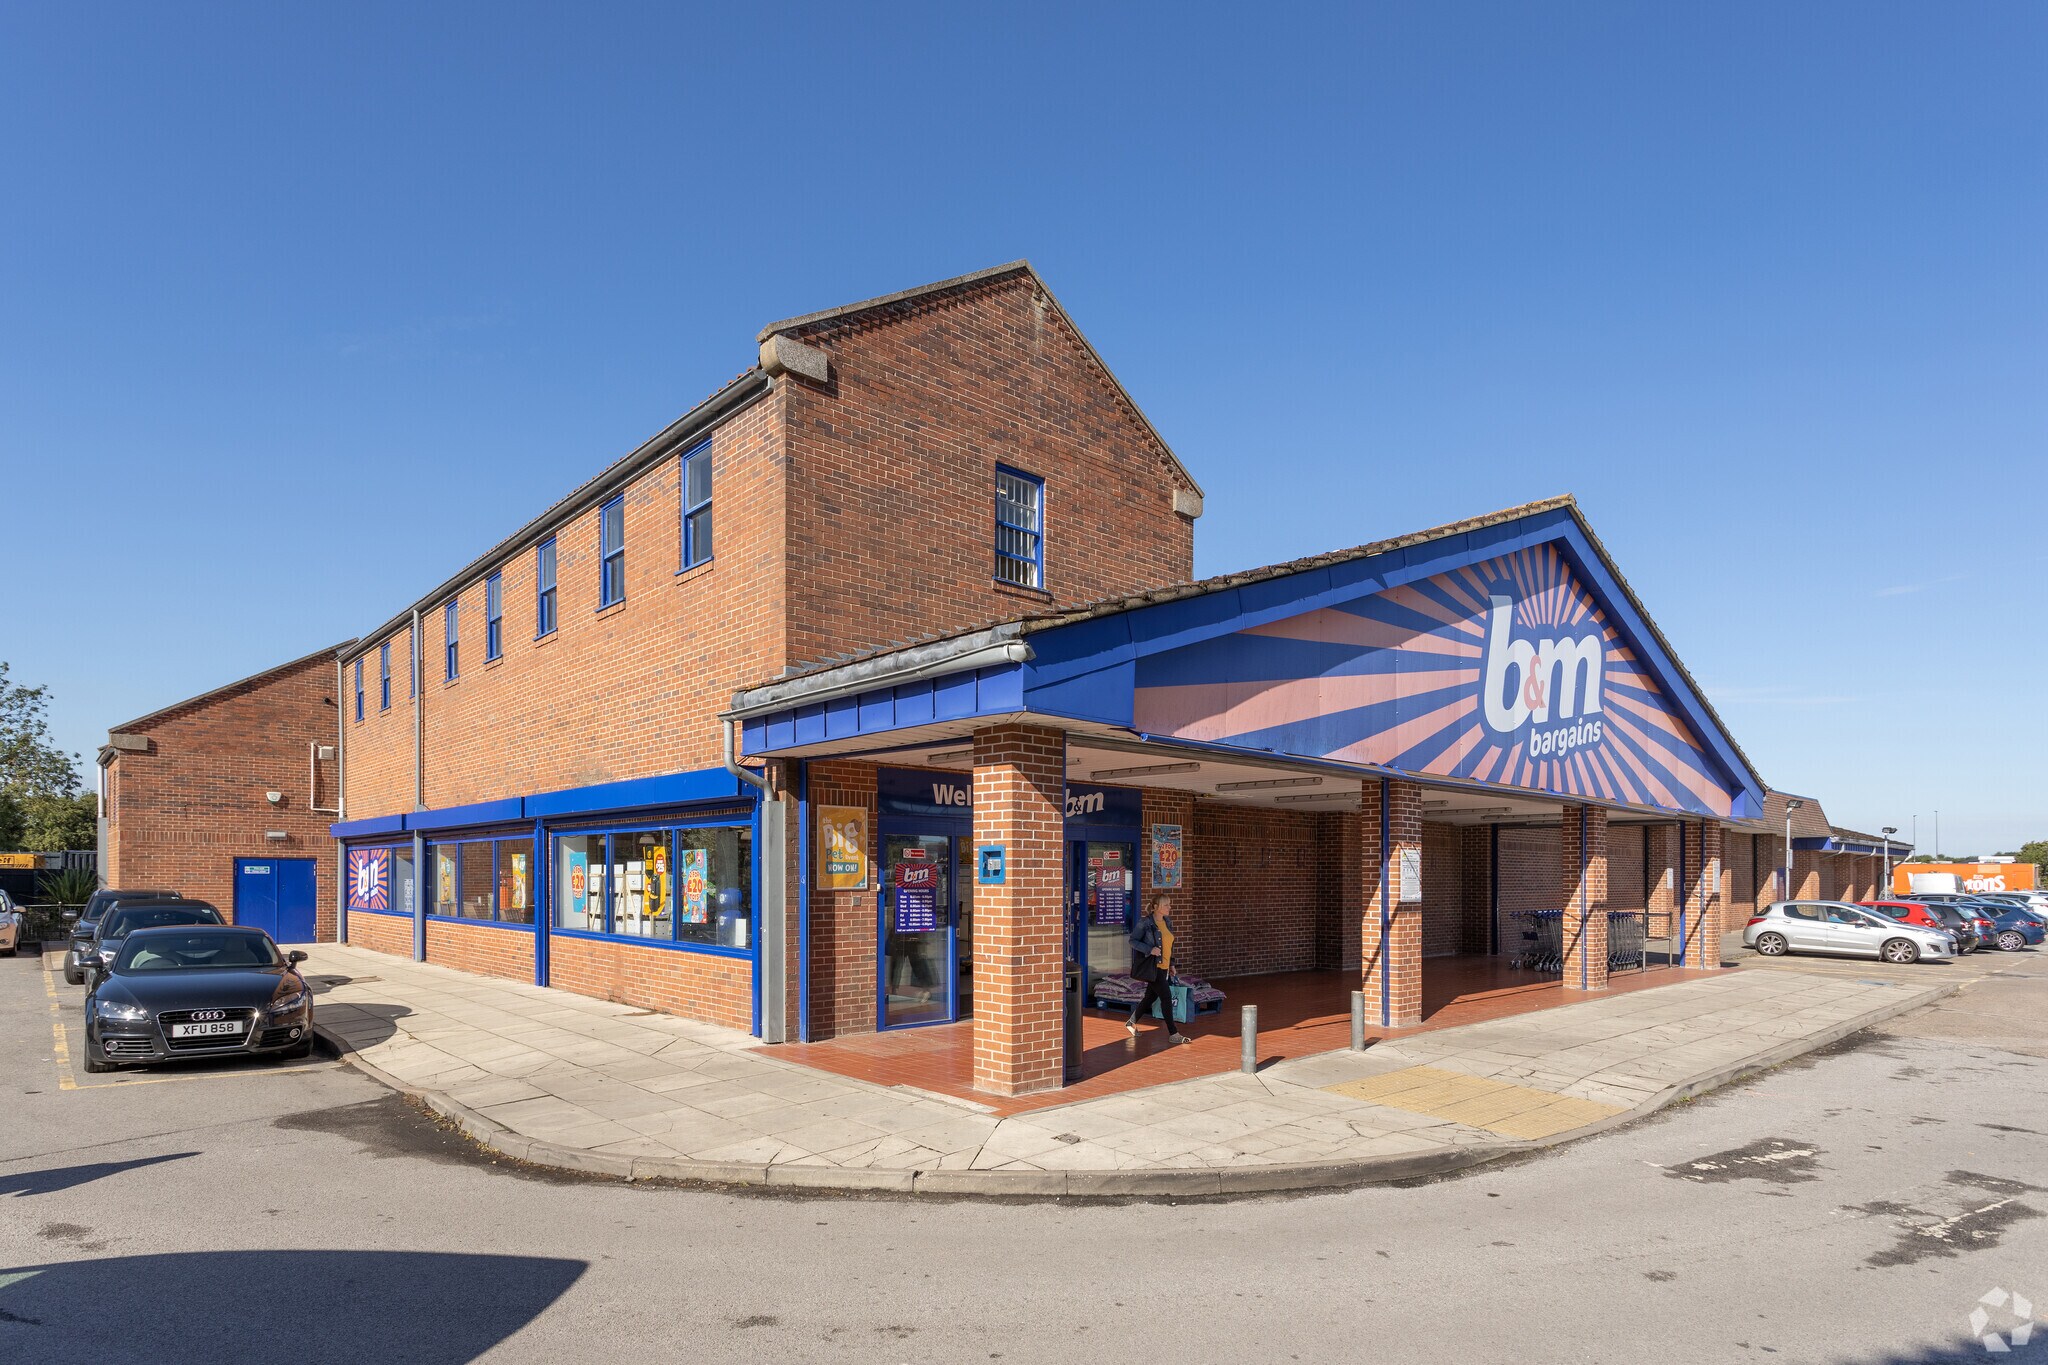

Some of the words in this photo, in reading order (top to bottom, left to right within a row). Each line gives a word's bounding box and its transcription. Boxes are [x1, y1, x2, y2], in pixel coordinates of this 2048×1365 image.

[1484, 595, 1603, 733] b&m
[1530, 717, 1602, 757] bargains
[826, 849, 843, 860] Pet
[1159, 850, 1178, 863] £20
[827, 864, 844, 872] NOW
[571, 874, 585, 890] £20
[687, 878, 703, 894] £20
[183, 1025, 208, 1036] XFU
[210, 1023, 235, 1034] 858
